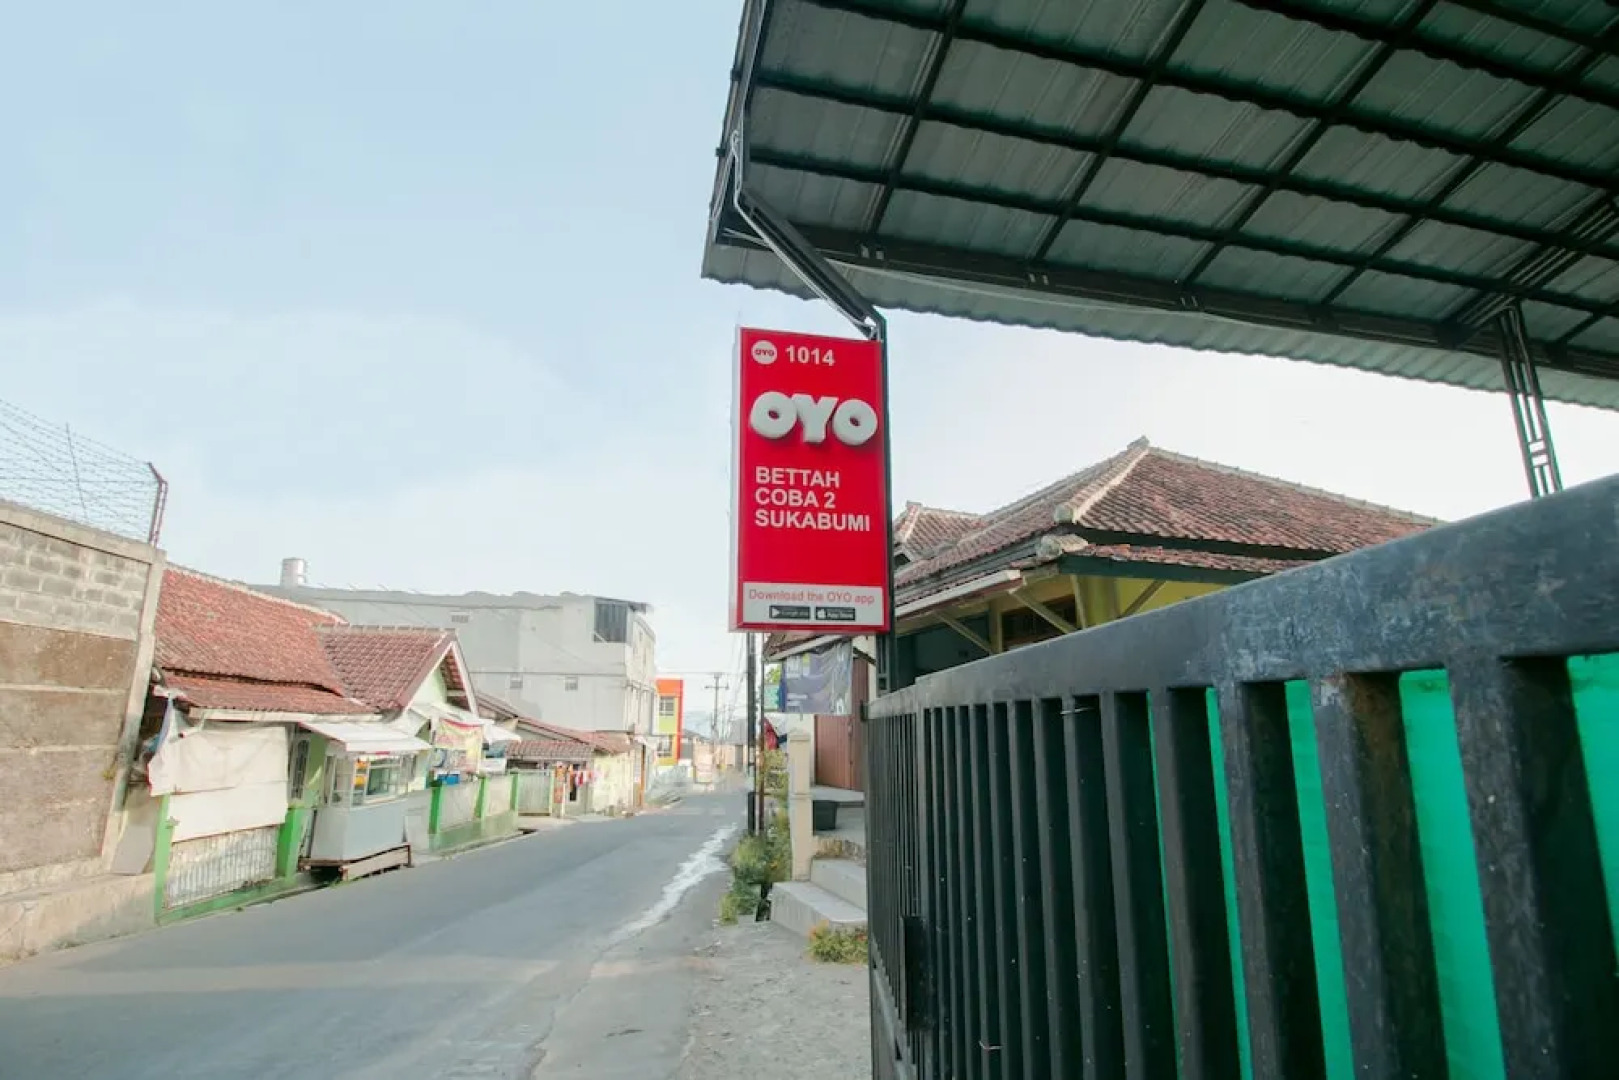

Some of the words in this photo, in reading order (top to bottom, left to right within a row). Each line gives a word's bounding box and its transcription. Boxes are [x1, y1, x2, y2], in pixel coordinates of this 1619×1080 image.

[785, 345, 836, 366] 1014
[750, 390, 878, 445] OYO
[755, 466, 840, 488] BETTAH
[755, 487, 819, 507] COBA
[824, 491, 836, 508] 2
[755, 509, 870, 532] SUKABUMI
[749, 589, 803, 601] Download
[807, 590, 823, 601] the
[827, 591, 852, 602] OYO
[854, 595, 875, 605] app
